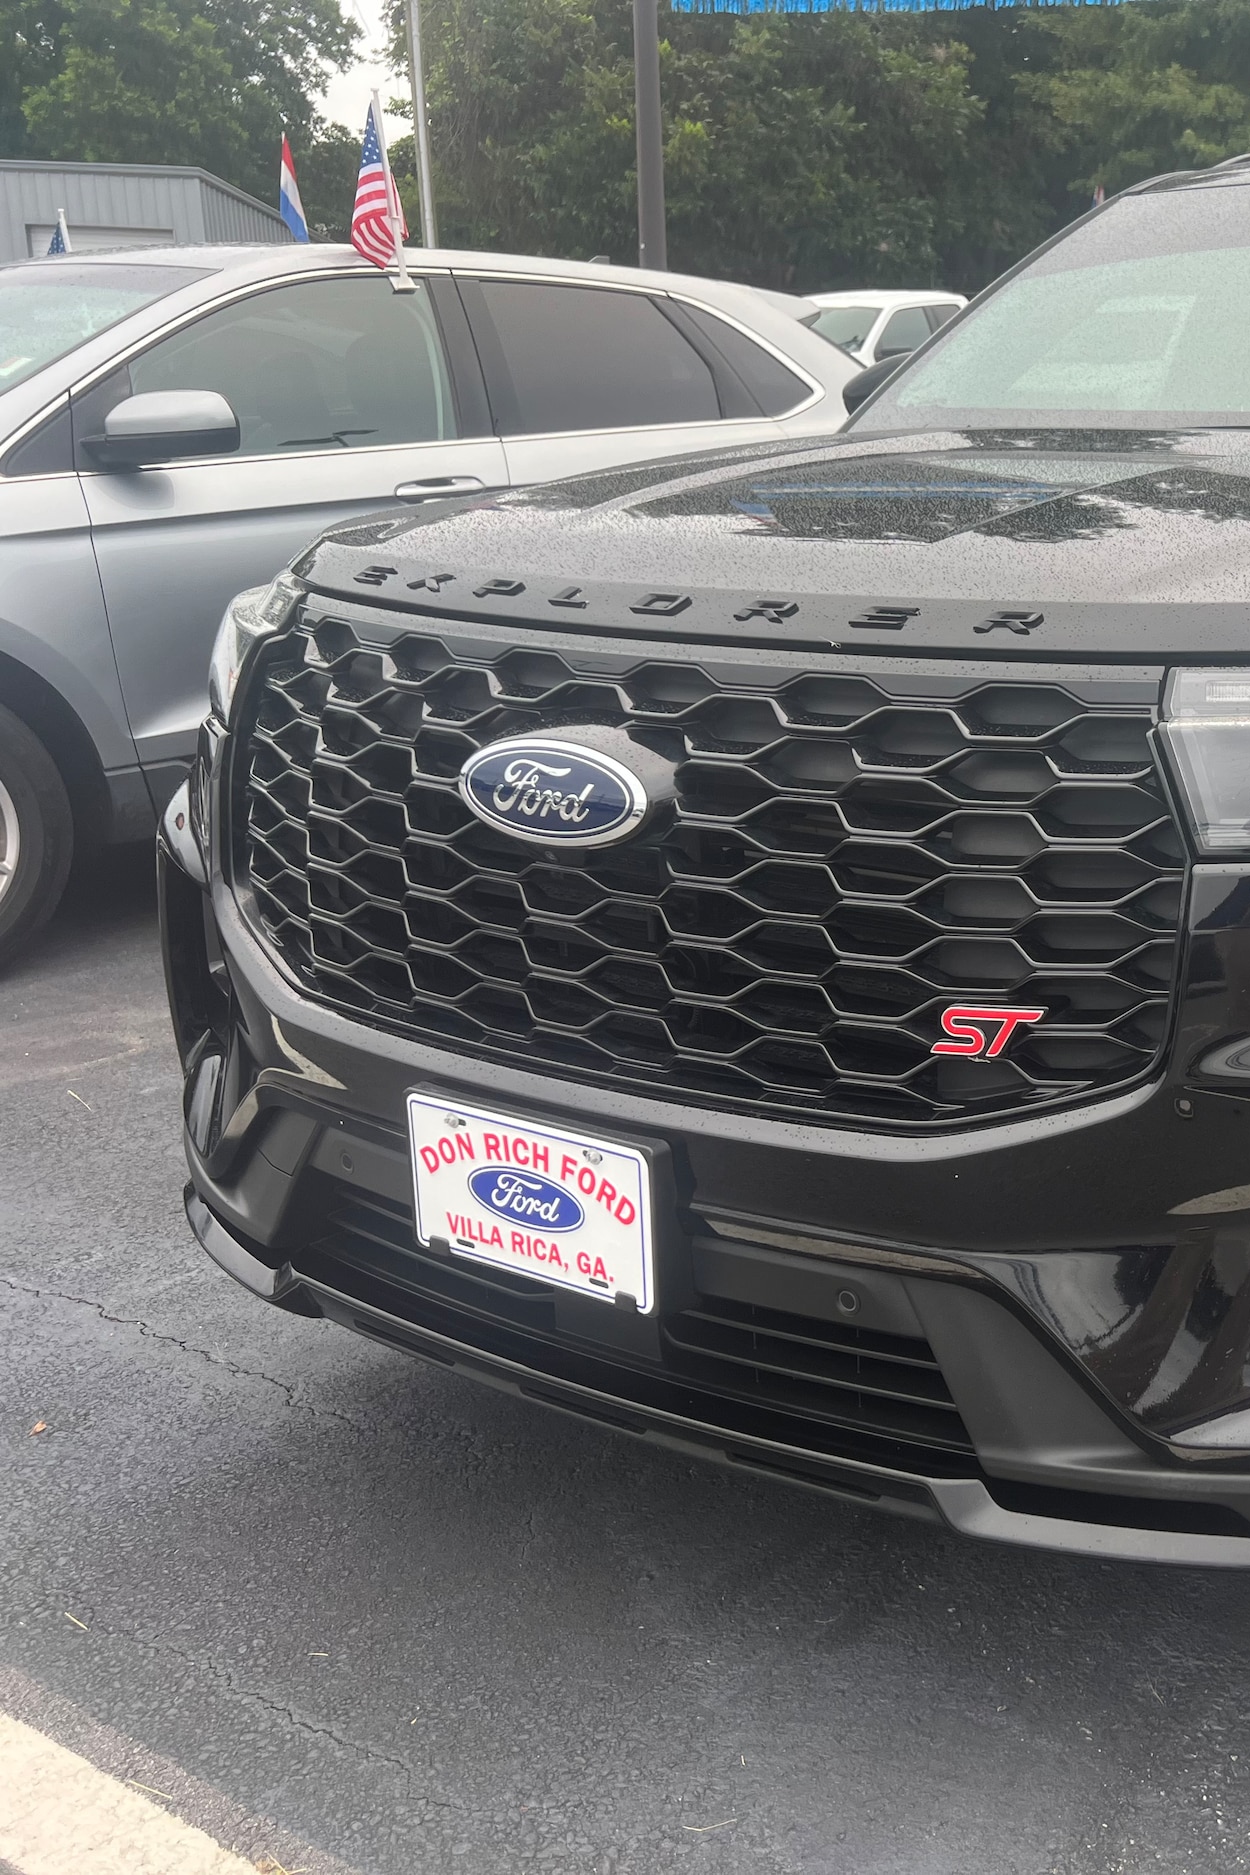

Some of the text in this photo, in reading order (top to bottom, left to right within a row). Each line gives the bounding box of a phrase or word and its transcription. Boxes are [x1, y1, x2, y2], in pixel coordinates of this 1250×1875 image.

[353, 565, 1044, 635] EXPLORER
[493, 759, 594, 822] Ford
[930, 1004, 1047, 1057] ST
[420, 1132, 636, 1226] DON RICH FORD
[491, 1173, 560, 1222] Ford
[446, 1211, 615, 1282] VILLA RICA, GA.
